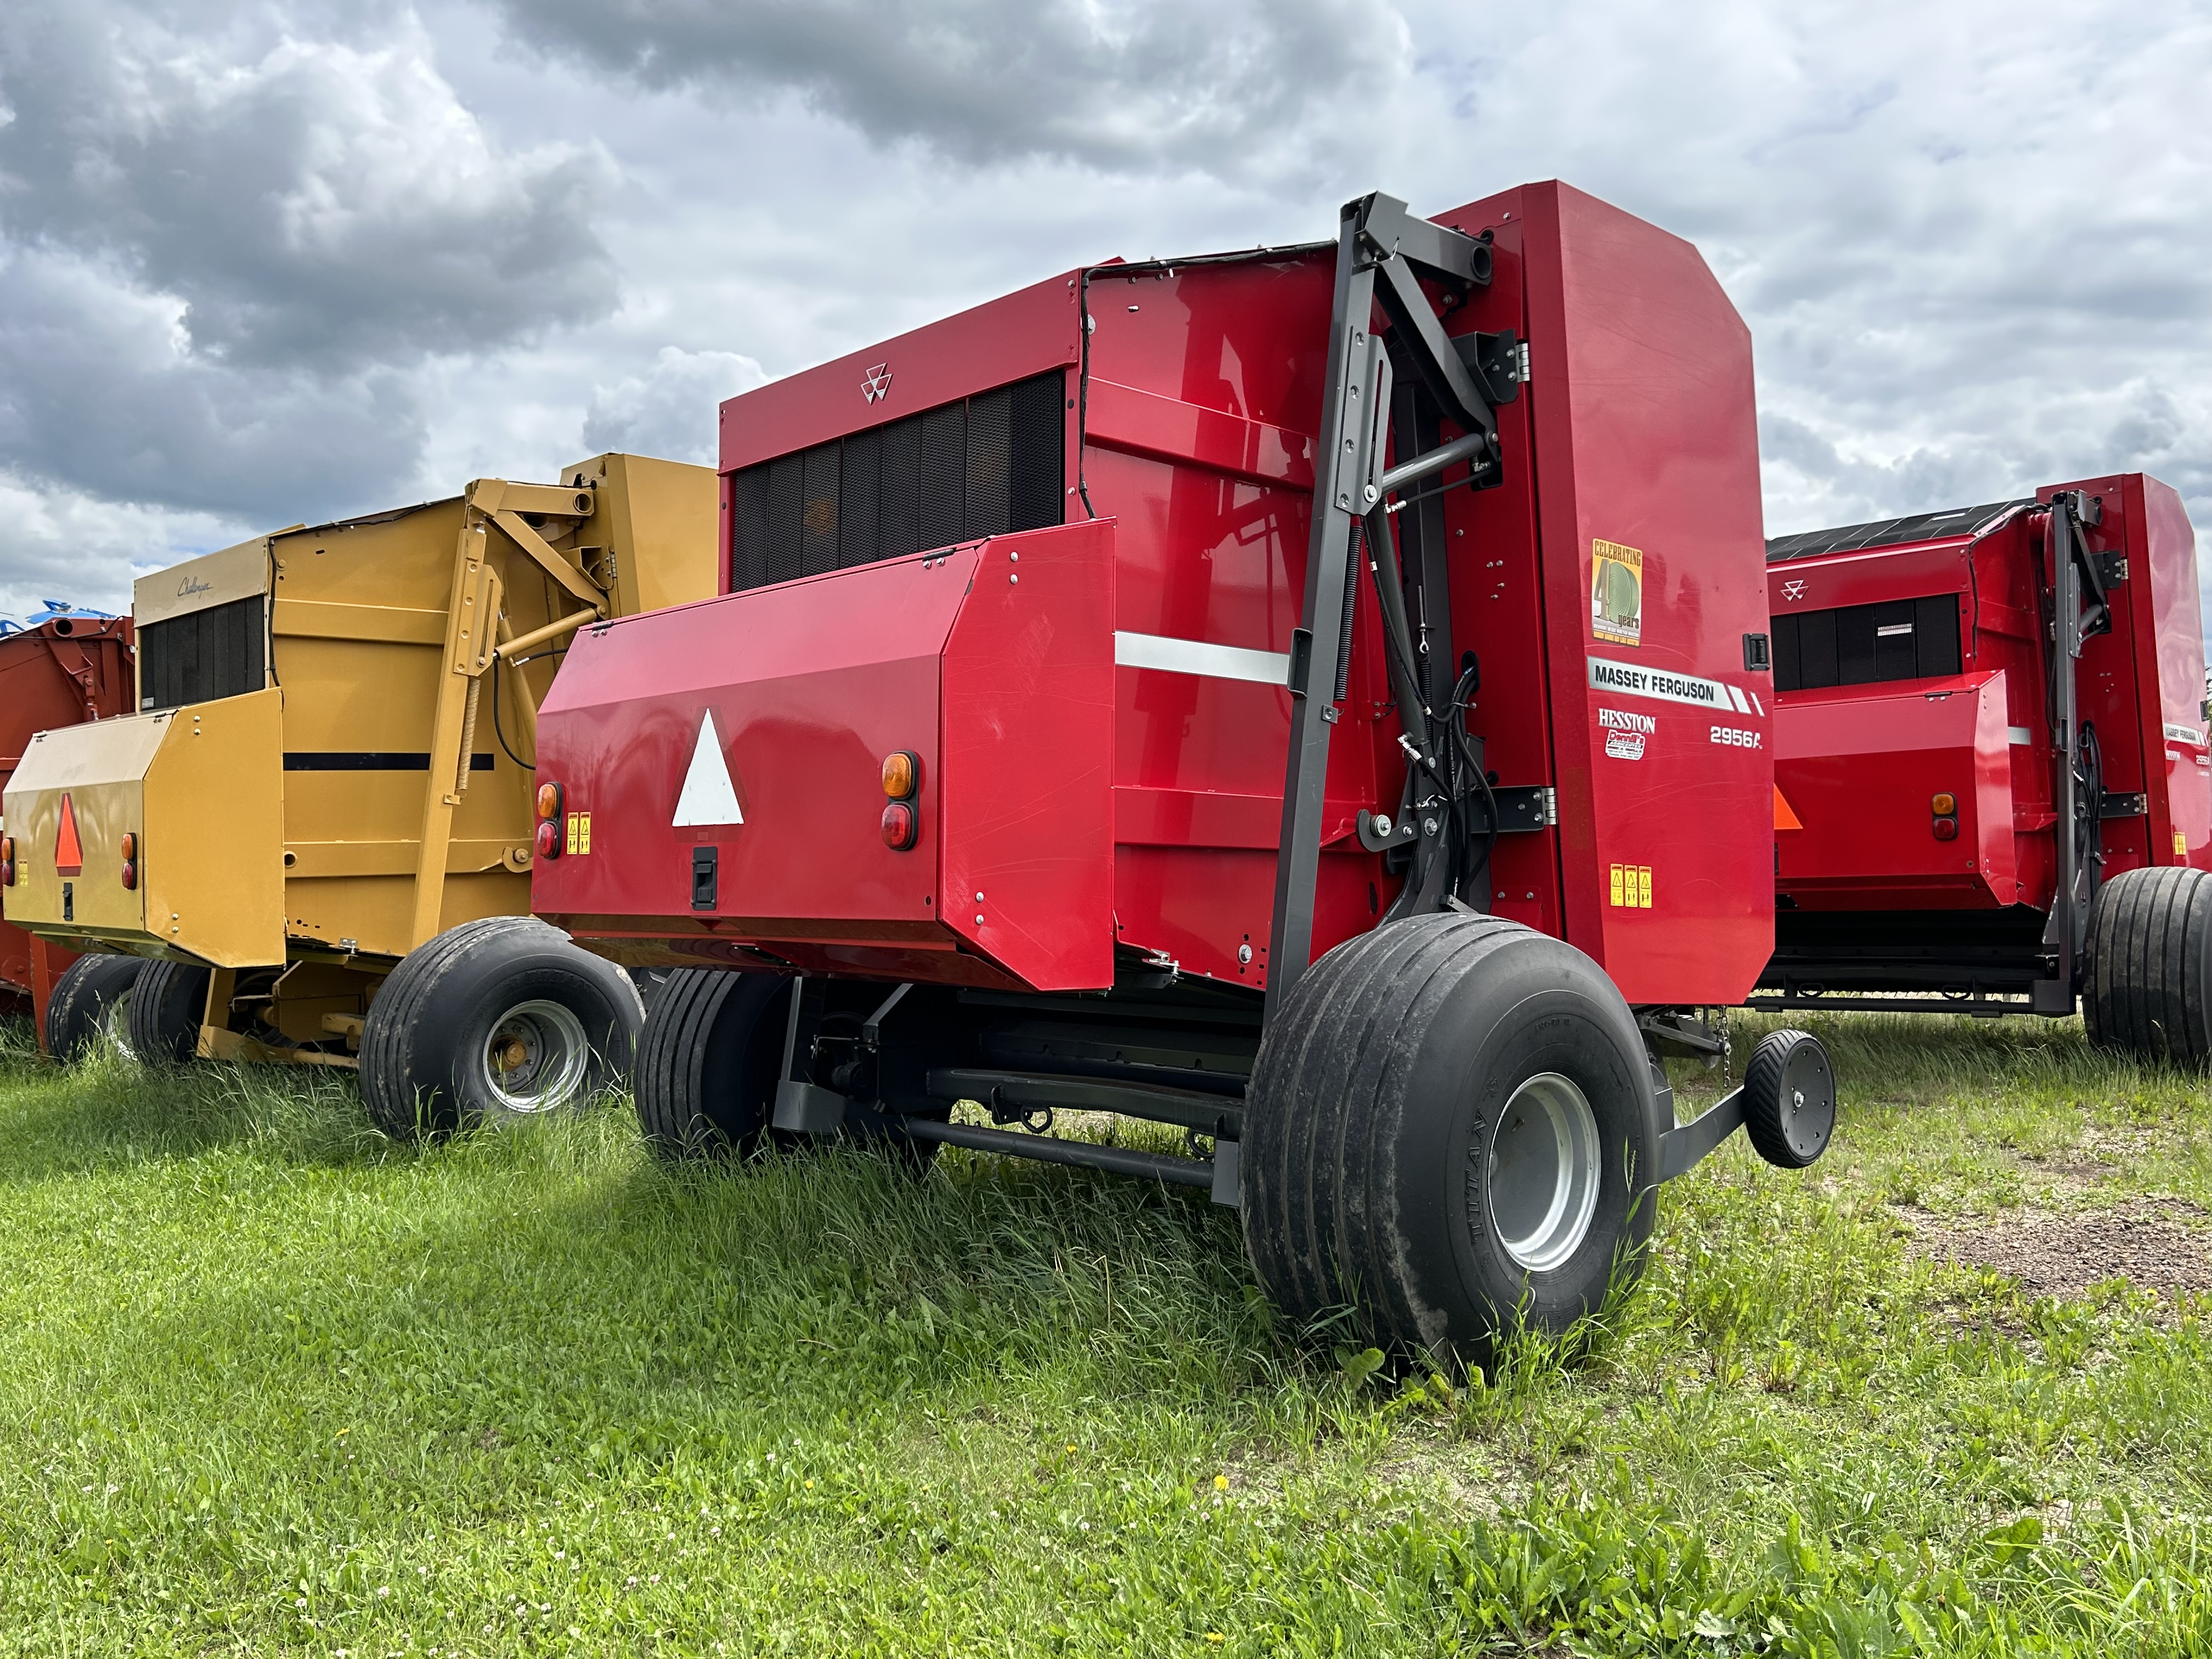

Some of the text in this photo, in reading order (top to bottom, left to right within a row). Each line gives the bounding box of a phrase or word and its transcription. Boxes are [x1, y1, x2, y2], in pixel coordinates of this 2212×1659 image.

[1595, 540, 1641, 567] CELEBRATING
[1618, 614, 1639, 629] years
[1595, 665, 1714, 702] MASSEY FERGUSON
[1598, 708, 1656, 735] HESSTON
[1465, 1108, 1487, 1244] TITAN
